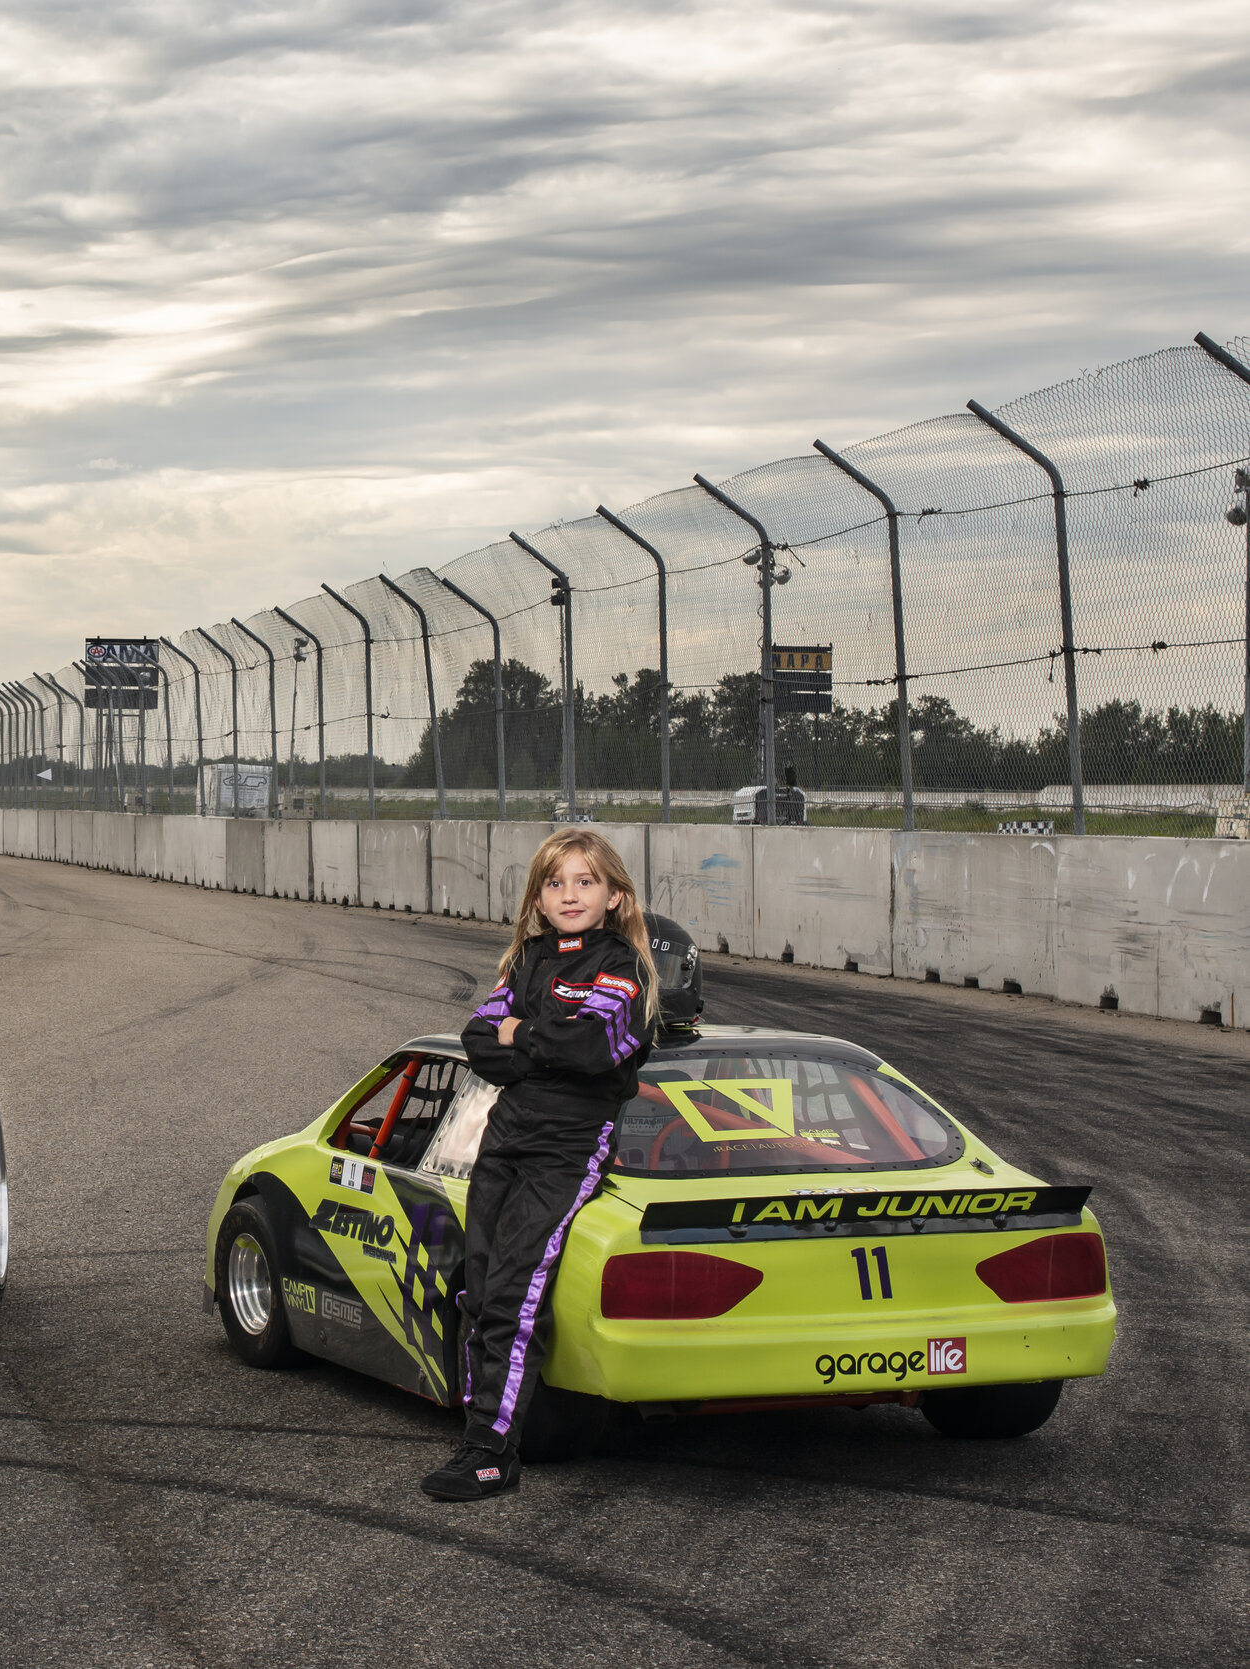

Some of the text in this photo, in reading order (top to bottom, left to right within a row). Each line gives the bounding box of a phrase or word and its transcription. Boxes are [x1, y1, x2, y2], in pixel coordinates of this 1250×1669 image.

[772, 653, 824, 668] NAPA
[308, 1198, 395, 1248] ZESTINO
[731, 1192, 1038, 1223] I AM JUNIOR
[282, 1278, 306, 1296] CAMP
[850, 1246, 893, 1300] 11
[284, 1292, 308, 1312] VINYL
[816, 1340, 964, 1384] garage life
